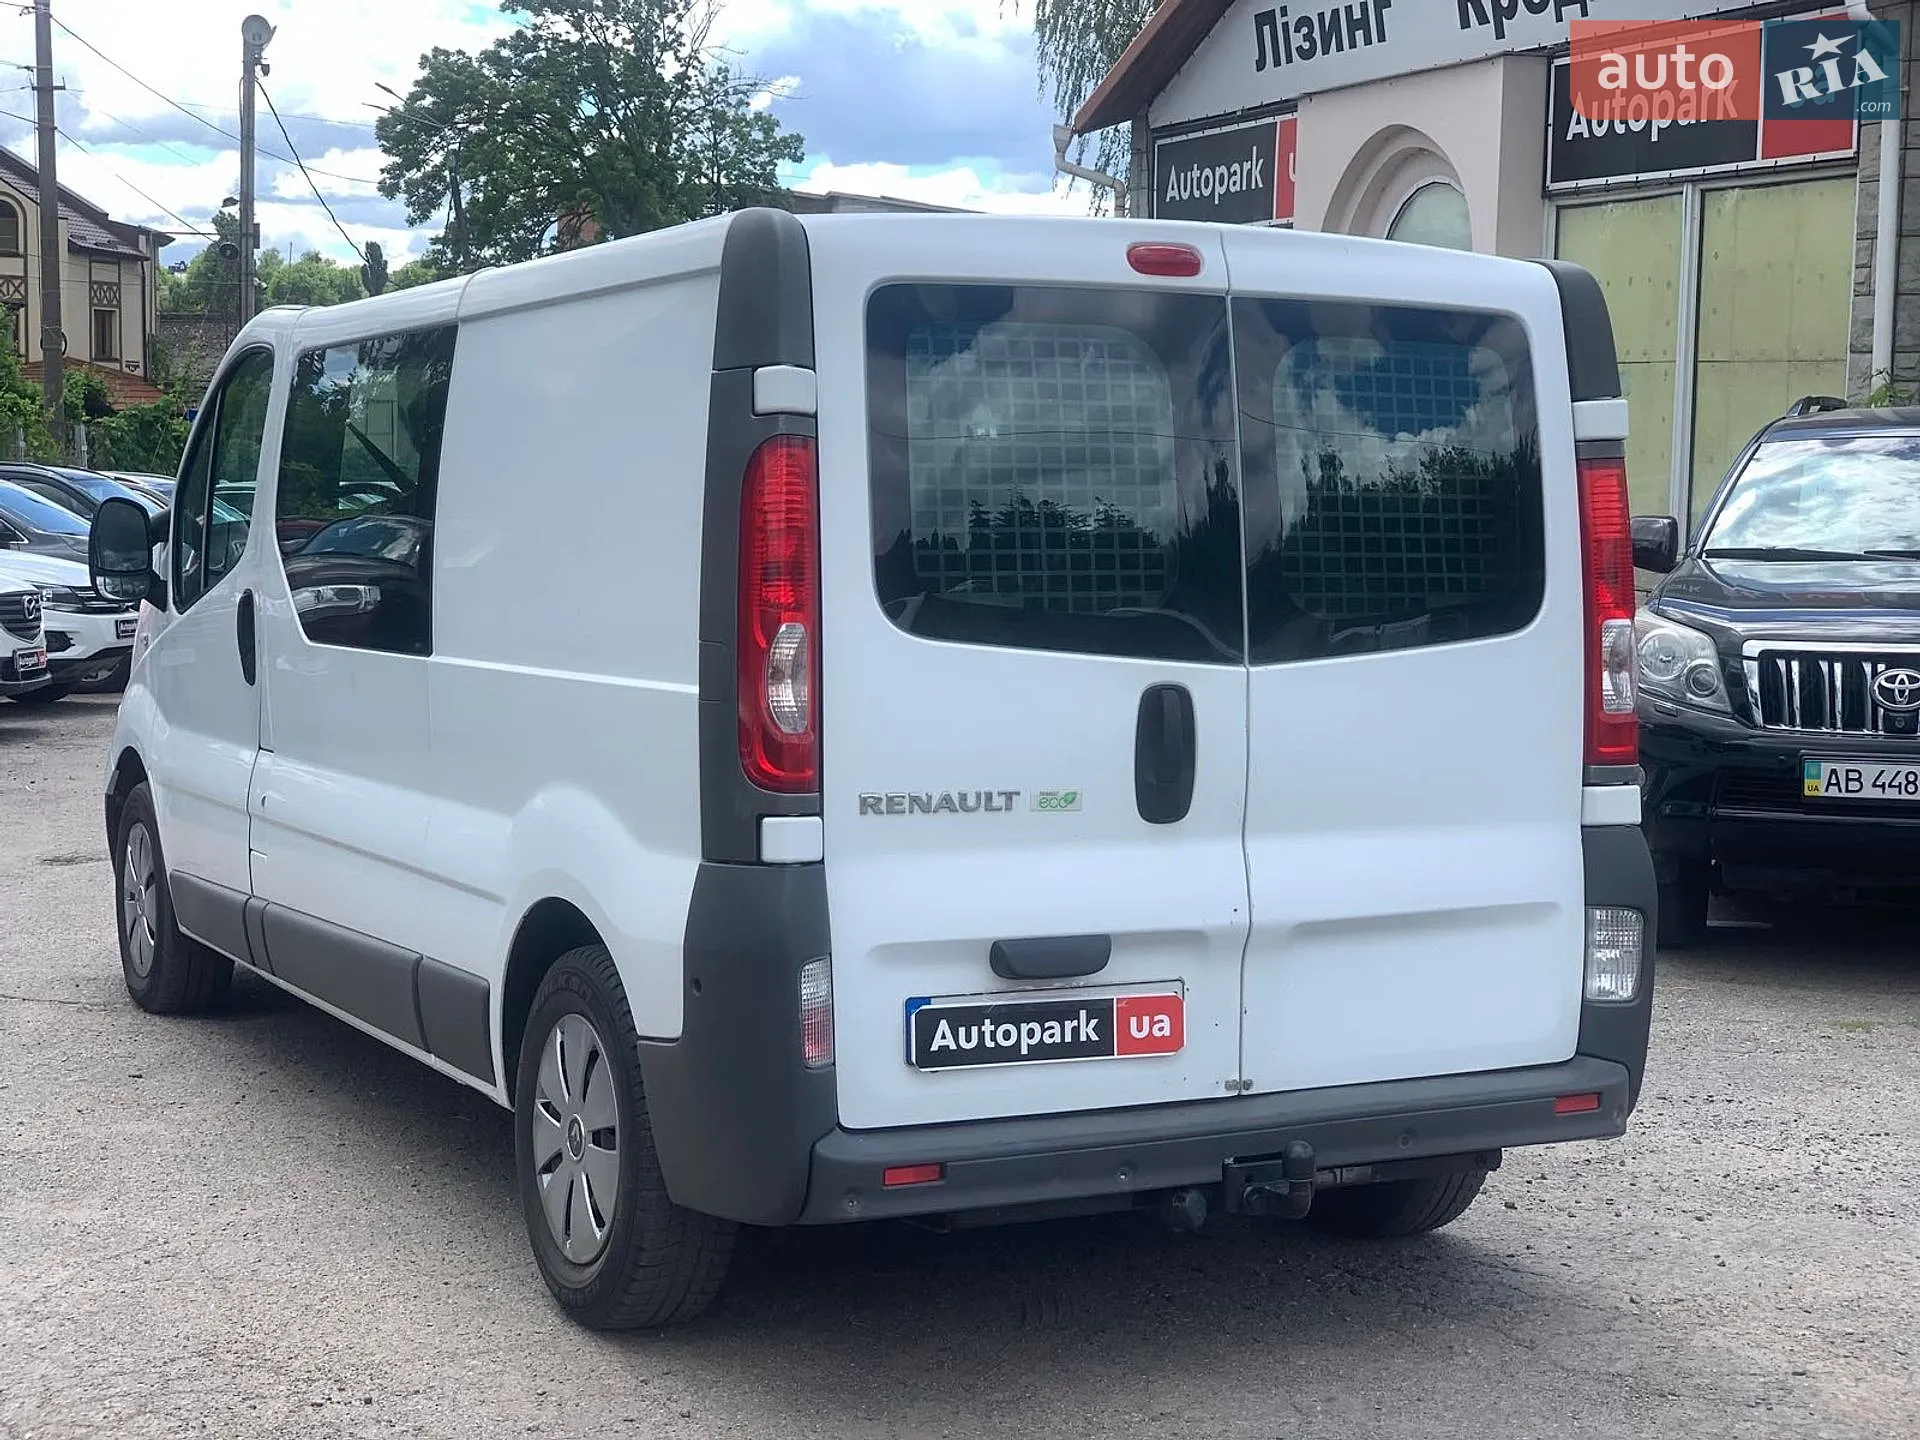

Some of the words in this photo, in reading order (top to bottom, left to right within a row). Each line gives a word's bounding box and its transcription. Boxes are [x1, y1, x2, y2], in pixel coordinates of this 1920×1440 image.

[1254, 0, 1392, 72] Лізинг
[1566, 62, 1740, 142] Autopark
[1165, 145, 1264, 205] Autopark
[858, 791, 1021, 816] RENAULT
[1824, 768, 1864, 793] AB
[1871, 769, 1919, 796] 448
[930, 1009, 1100, 1055] Autopark
[1129, 1013, 1171, 1040] ua
